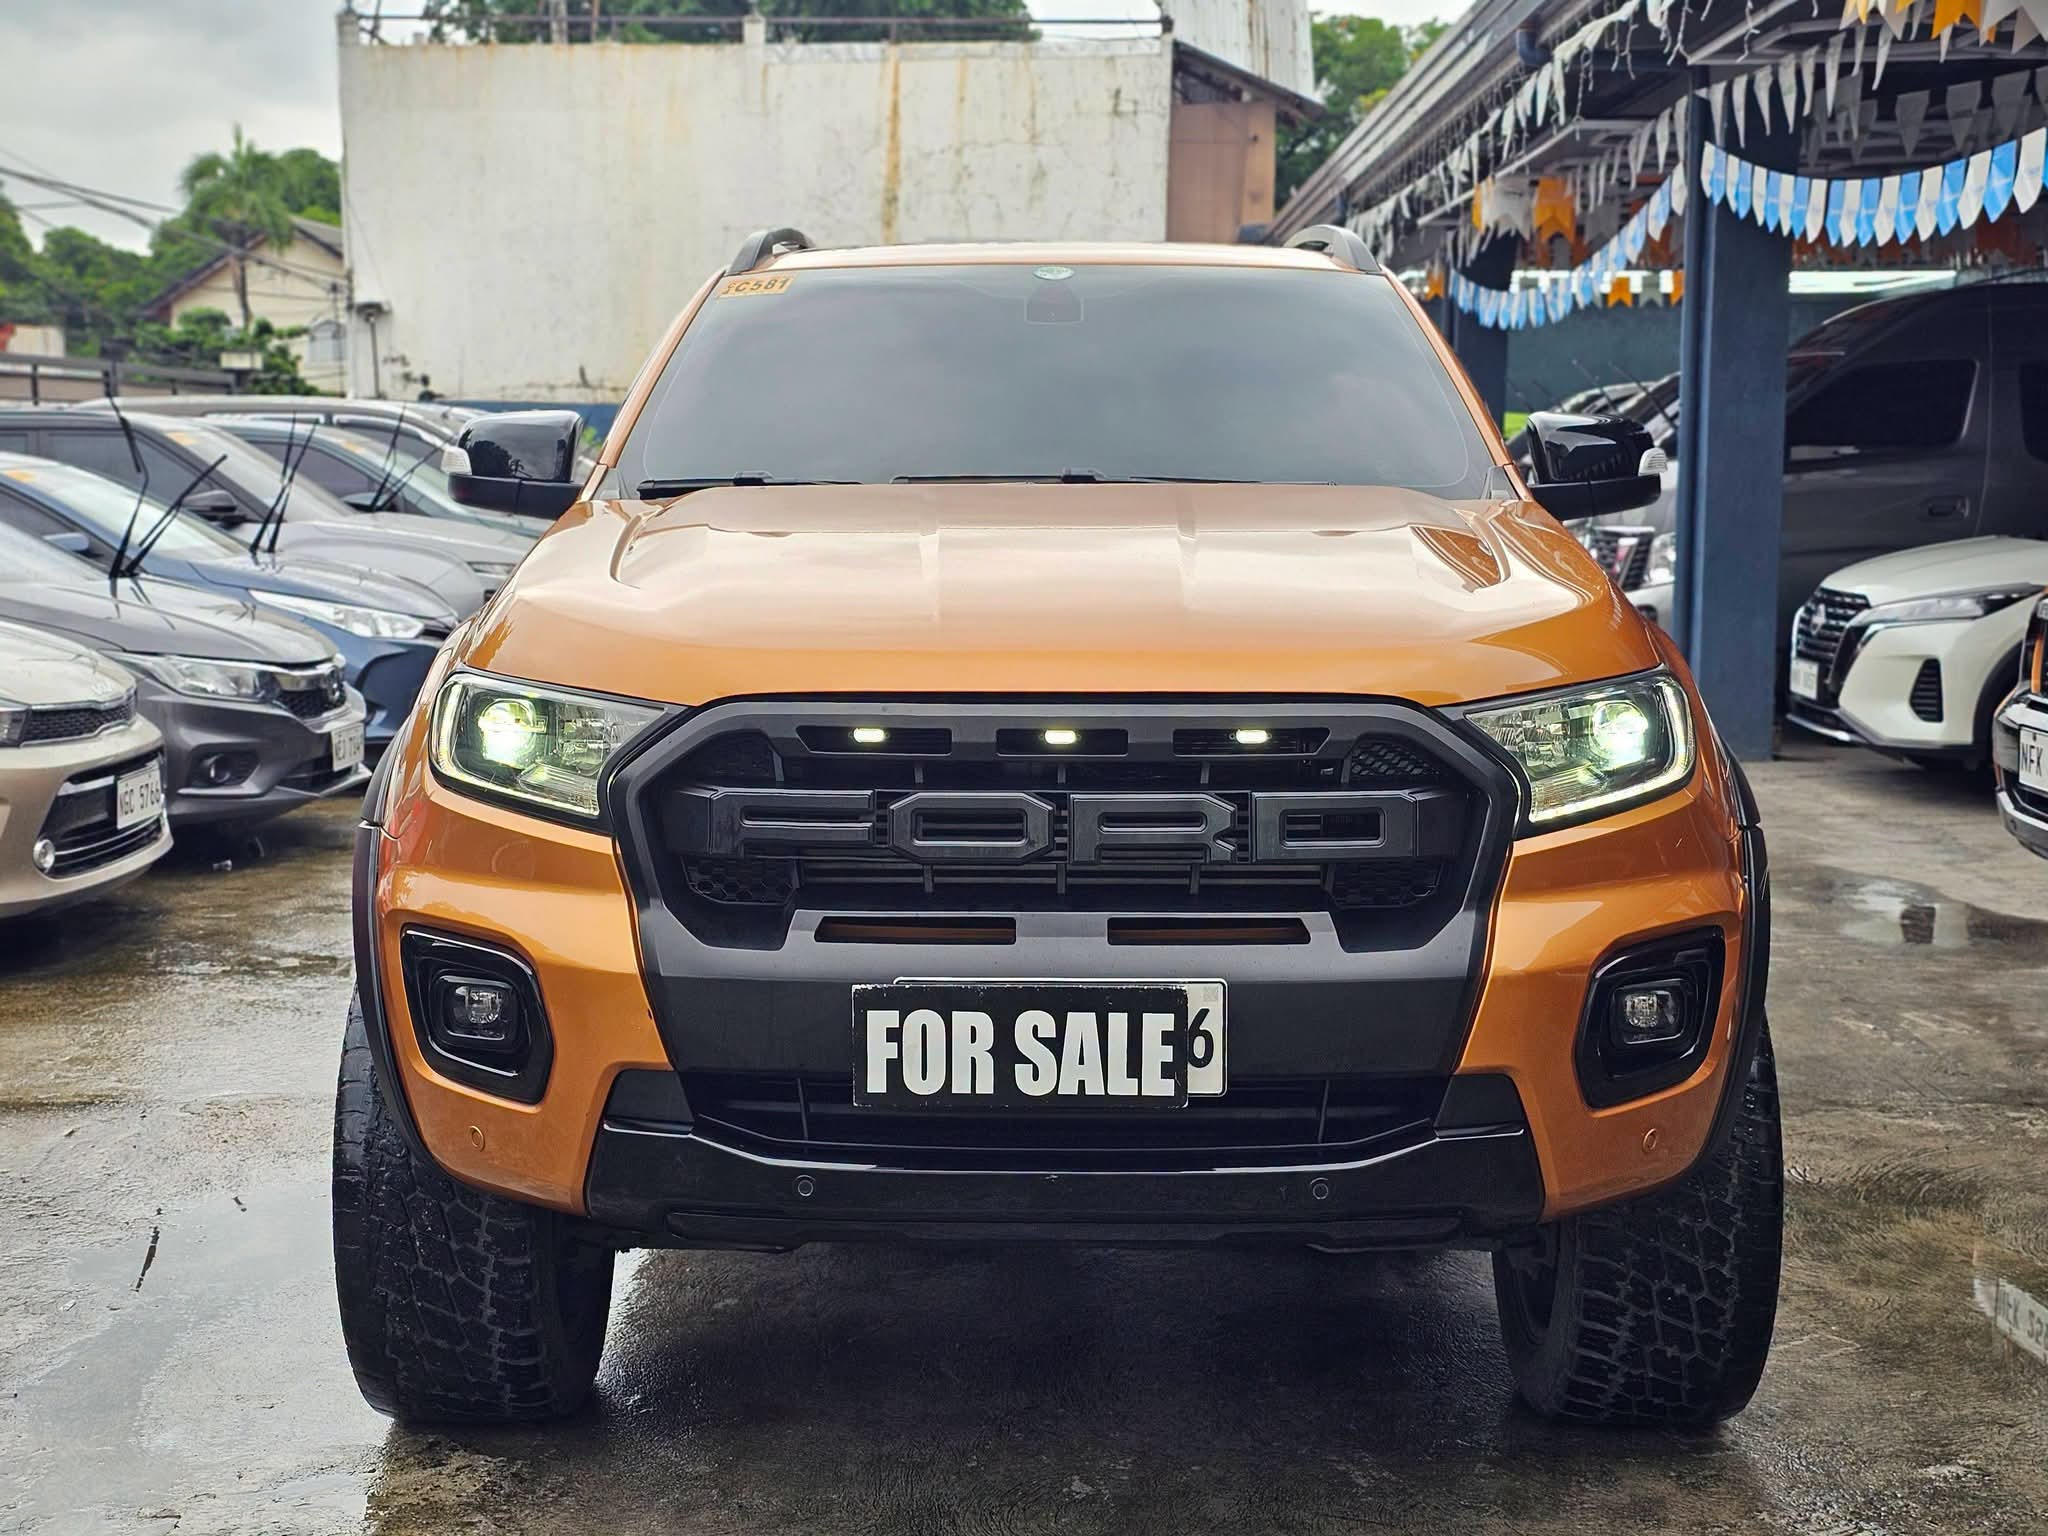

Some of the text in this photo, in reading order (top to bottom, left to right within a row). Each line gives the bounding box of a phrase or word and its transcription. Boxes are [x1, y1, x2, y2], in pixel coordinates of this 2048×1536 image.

[2021, 742, 2043, 777] NFX
[709, 789, 1417, 864] FORD
[865, 1009, 1176, 1097] FOR SALE
[1187, 1007, 1215, 1069] 6
